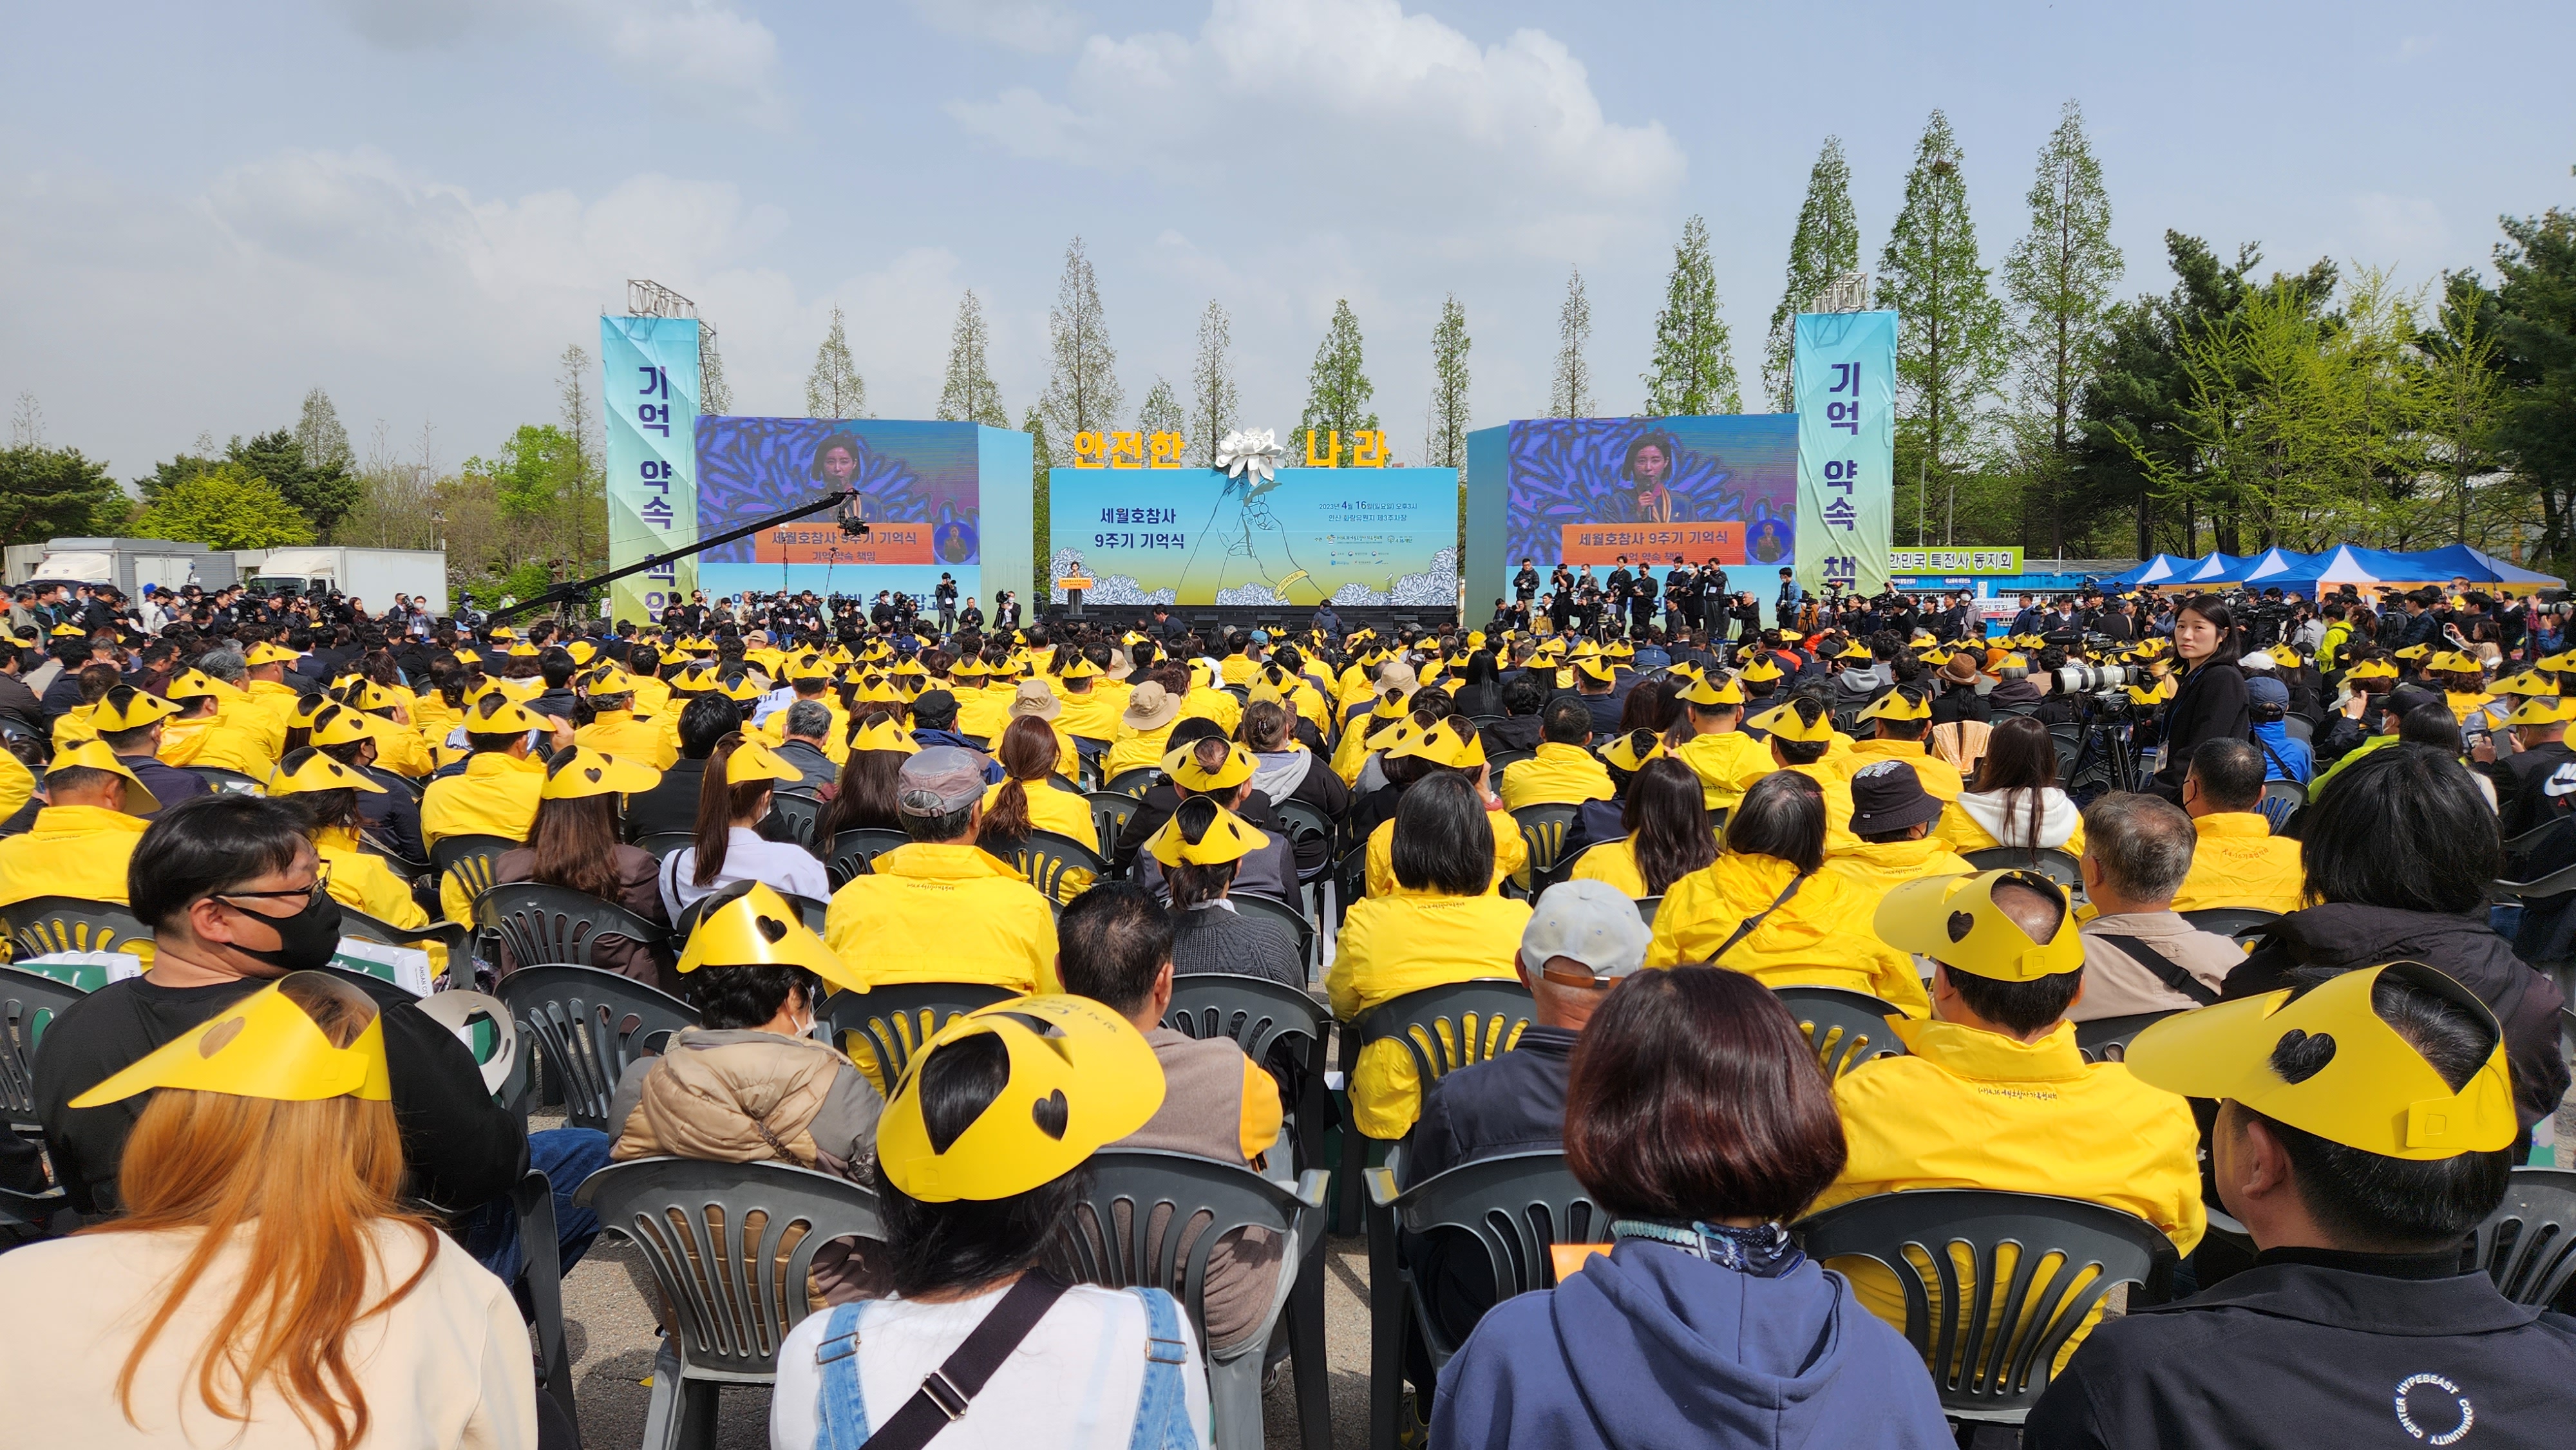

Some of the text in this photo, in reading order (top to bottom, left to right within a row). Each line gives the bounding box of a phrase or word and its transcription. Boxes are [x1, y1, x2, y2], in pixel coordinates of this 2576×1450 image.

[638, 366, 670, 438] 기억
[1826, 362, 1861, 435] 기억
[1074, 430, 1390, 469] 안전한 나라
[640, 460, 674, 530] 약속
[1823, 460, 1857, 531] 약속
[1341, 501, 1353, 510] 4월
[1356, 501, 1394, 511] 16일(일요일)
[1100, 508, 1177, 524] 세월호참사
[772, 531, 837, 545] 세월호참사
[880, 531, 917, 545] 기억식
[1095, 533, 1184, 549] 9주기 기억식
[1578, 531, 1728, 546] 세월호참사 9주기 기억식
[813, 551, 876, 561] 기억 약속 책임
[1642, 552, 1661, 562] 약속
[1931, 553, 1969, 569] 특전사
[1974, 552, 2012, 569] 동지회
[2395, 1374, 2474, 1445] HYPEBEAST COMMUNITY CENTER
